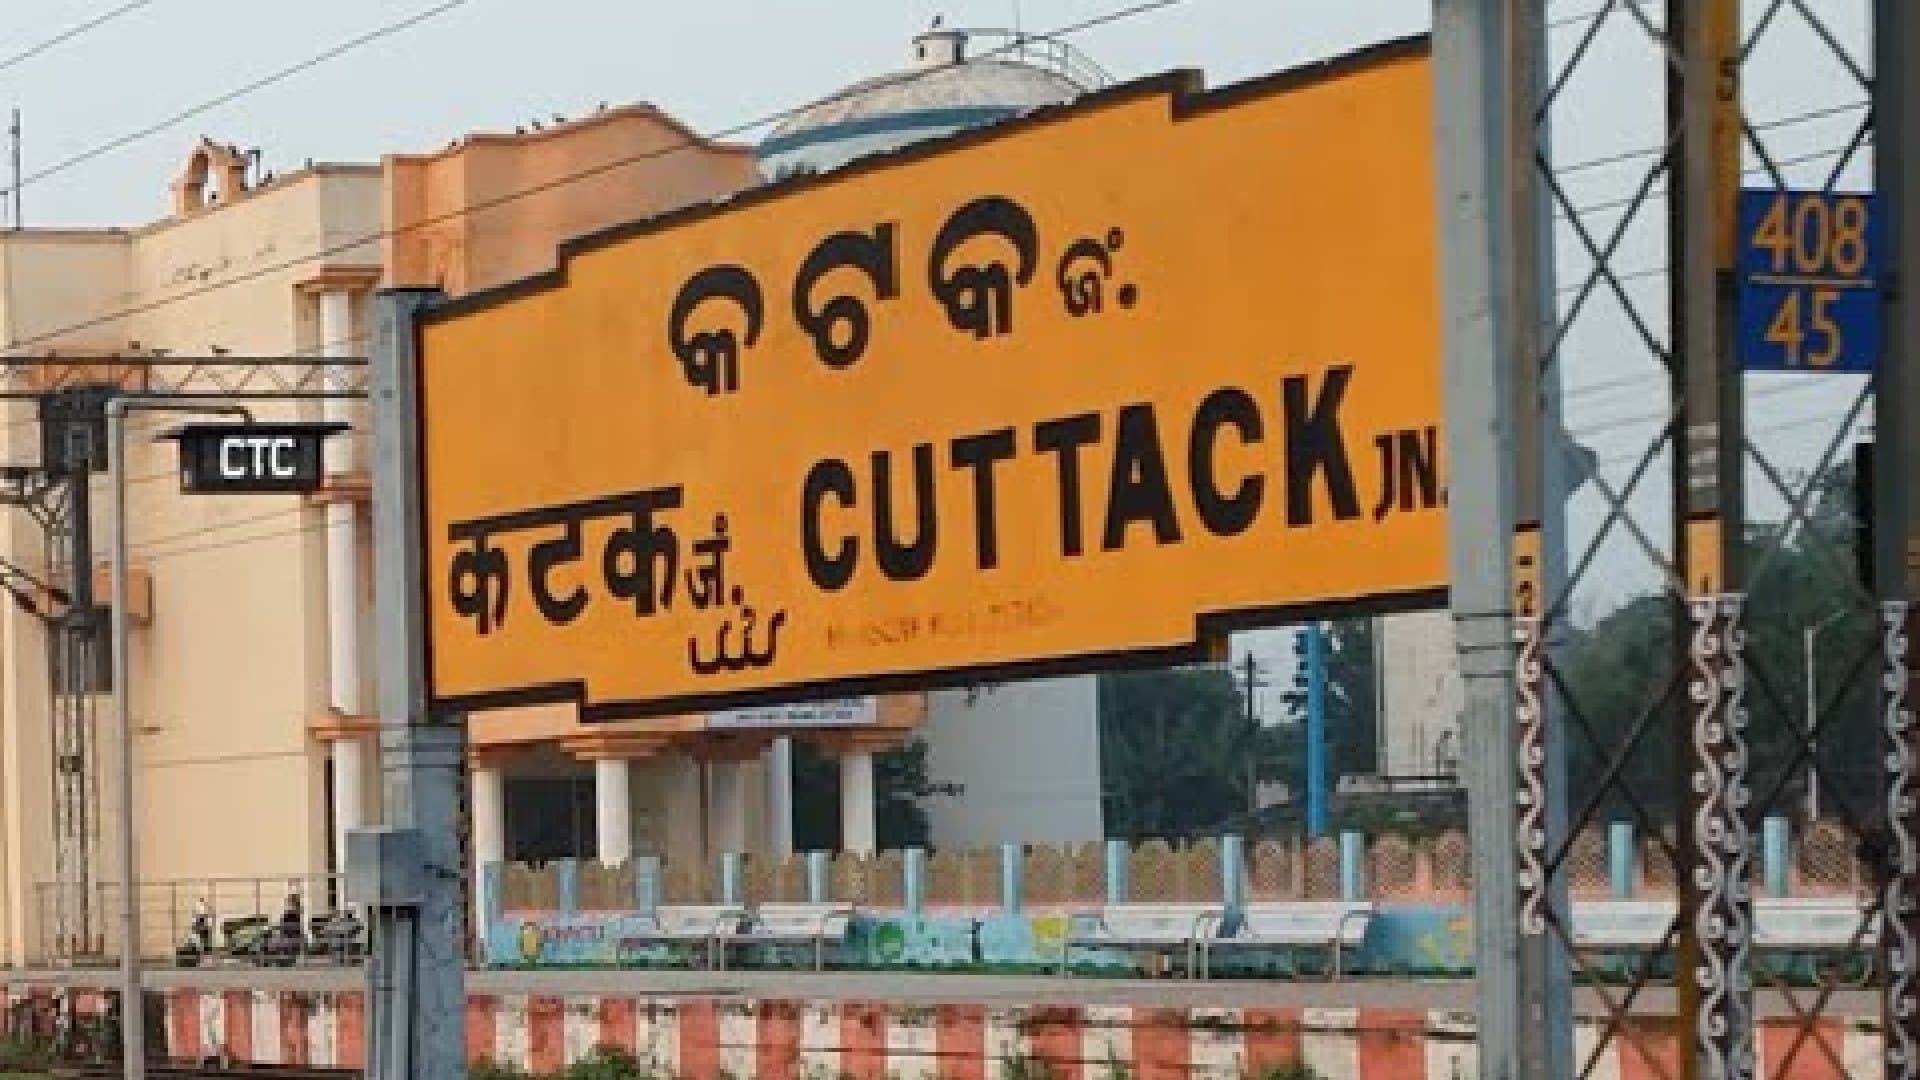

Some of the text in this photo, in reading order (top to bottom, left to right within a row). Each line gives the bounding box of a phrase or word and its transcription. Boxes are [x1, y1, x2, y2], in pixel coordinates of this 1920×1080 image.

[1750, 195, 1868, 275] 408
[1763, 286, 1841, 366] 45
[219, 435, 296, 480] CTC
[801, 364, 1363, 592] CUTTACK
[446, 484, 684, 635] कटक
